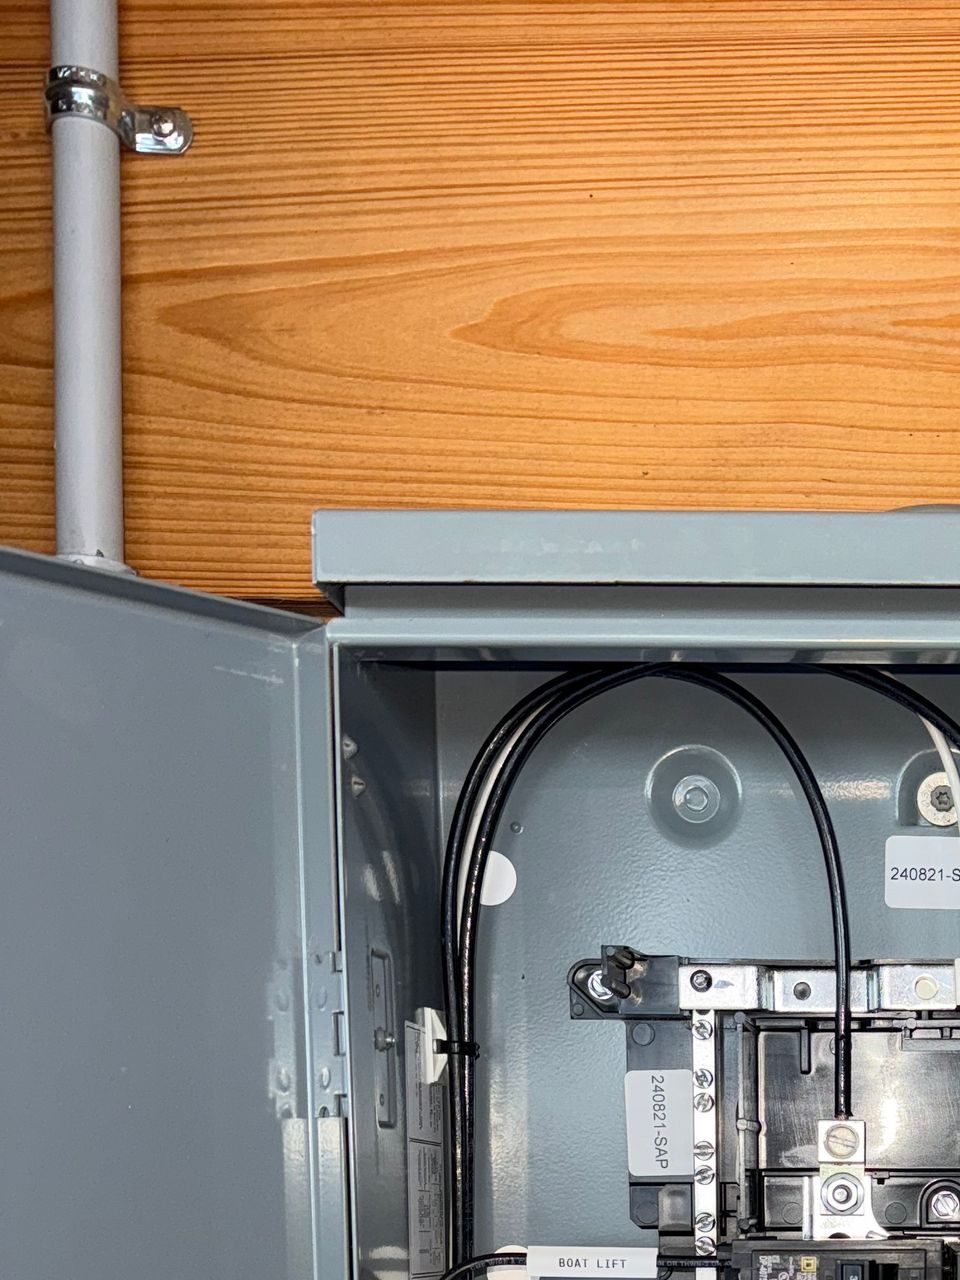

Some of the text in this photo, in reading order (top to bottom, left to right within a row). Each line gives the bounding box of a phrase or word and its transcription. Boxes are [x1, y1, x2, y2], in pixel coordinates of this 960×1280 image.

[651, 1075, 669, 1169] 240821-SAP
[558, 1257, 628, 1269] BOAT LIFT
